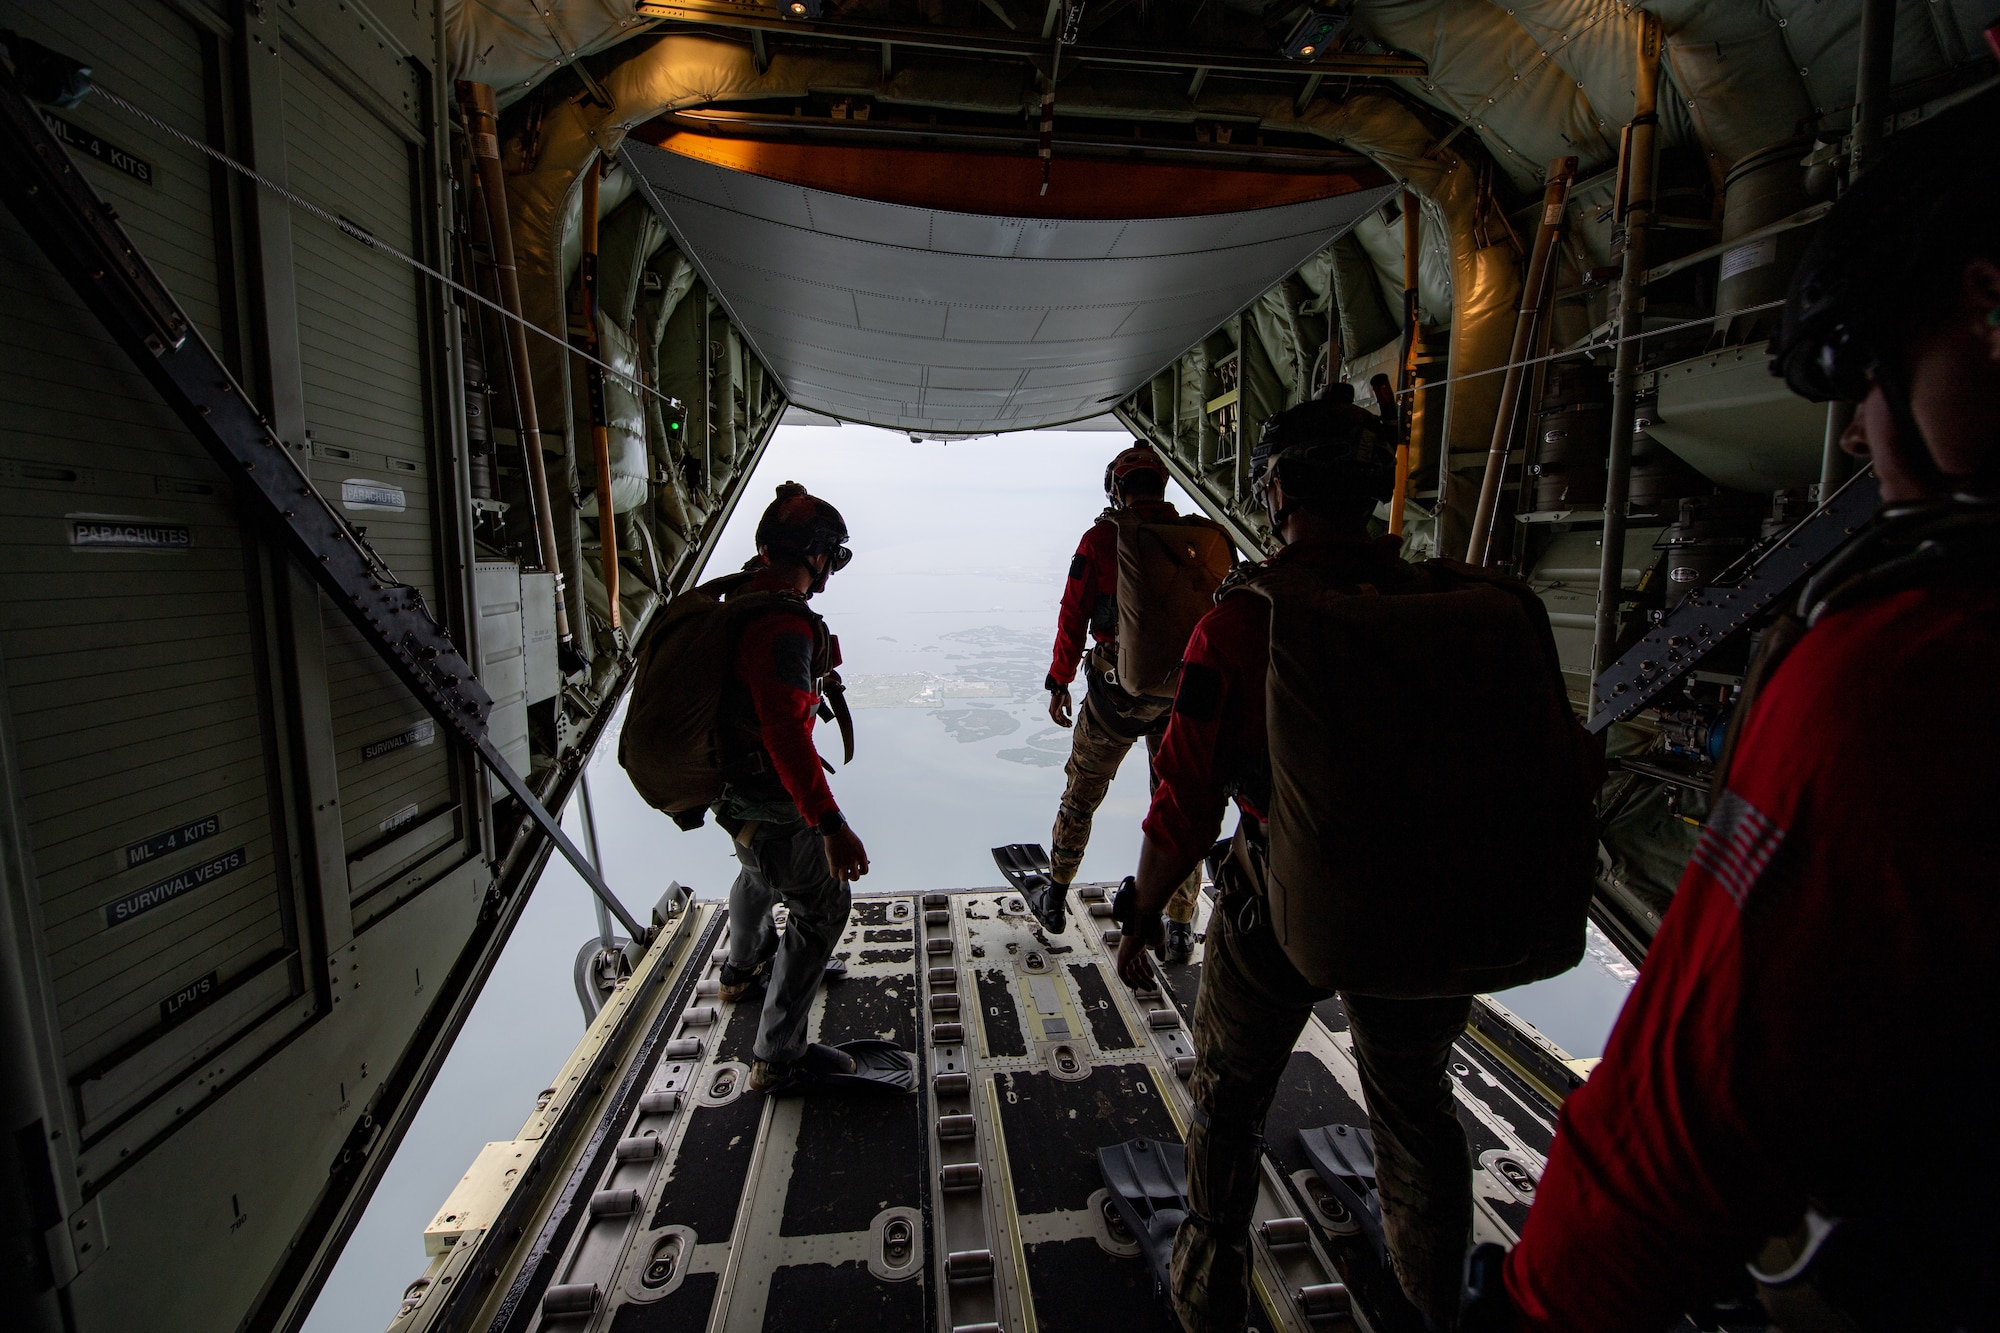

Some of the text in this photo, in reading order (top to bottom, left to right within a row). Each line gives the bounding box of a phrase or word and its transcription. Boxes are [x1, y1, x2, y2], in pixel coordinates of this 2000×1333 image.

[45, 114, 75, 143] ML
[90, 140, 100, 156] 4
[110, 148, 148, 180] KITS
[346, 486, 402, 504] PARACHUTES
[77, 525, 189, 544] PARACHUTES
[366, 736, 404, 757] SURVIVAL
[130, 844, 154, 864] ML
[167, 834, 177, 848] 4
[184, 819, 217, 842] KITS
[115, 853, 240, 919] SURVIVAL VESTS
[168, 978, 210, 1015] LPU'S
[230, 1213, 247, 1235] 780
